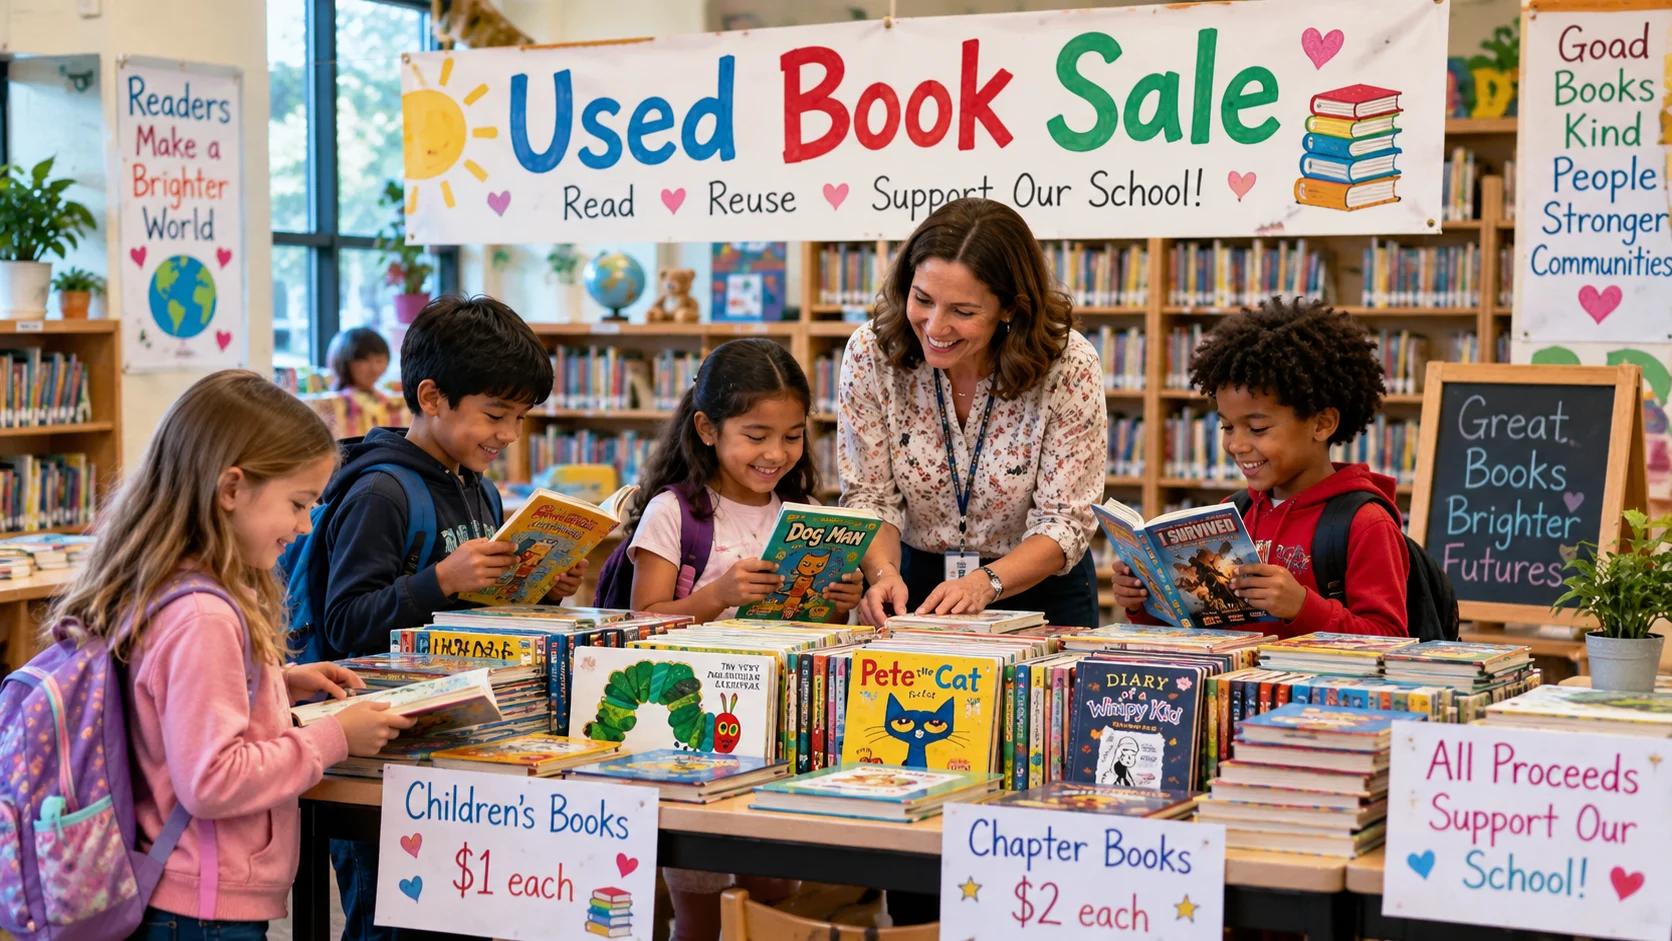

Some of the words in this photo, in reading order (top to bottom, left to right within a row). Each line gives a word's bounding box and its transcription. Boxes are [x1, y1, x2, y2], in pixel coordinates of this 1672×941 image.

[128, 75, 230, 124] Readers
[510, 54, 736, 173] Used
[780, 37, 1014, 164] Book
[1046, 27, 1281, 152] Sale
[1555, 67, 1655, 106] Books
[136, 125, 196, 159] Make
[207, 140, 221, 159] a
[1565, 111, 1642, 149] Kind
[132, 163, 229, 210] Brighter
[563, 184, 635, 220] Read
[708, 180, 797, 216] Reuse
[1013, 172, 1071, 208] Our
[1088, 168, 1203, 207] School!
[1553, 155, 1657, 203] People
[142, 203, 215, 241] World
[1542, 201, 1669, 246] Stronger
[1530, 243, 1672, 277] Communities
[1458, 395, 1569, 443] Great
[1465, 447, 1567, 491] Books
[1157, 531, 1168, 547] I
[1167, 518, 1237, 545] SURVIVED
[1446, 495, 1582, 550] Brighter
[1443, 542, 1563, 587] Futures
[860, 658, 915, 687] Pete
[935, 664, 982, 692] Cat
[1106, 673, 1169, 691] DIARY
[1149, 699, 1184, 725] Kid
[1426, 739, 1473, 781] All
[1493, 742, 1639, 794] Proceeds
[405, 780, 535, 829] Children's
[550, 793, 629, 840] Books
[1429, 792, 1559, 847] Support
[1576, 804, 1638, 844] Our
[968, 818, 1088, 872] Chapter
[1104, 828, 1192, 874] Books
[453, 841, 494, 898] $1
[507, 862, 574, 902] each
[1462, 849, 1588, 898] School!
[1011, 875, 1062, 928] $2
[1078, 892, 1149, 933] each
